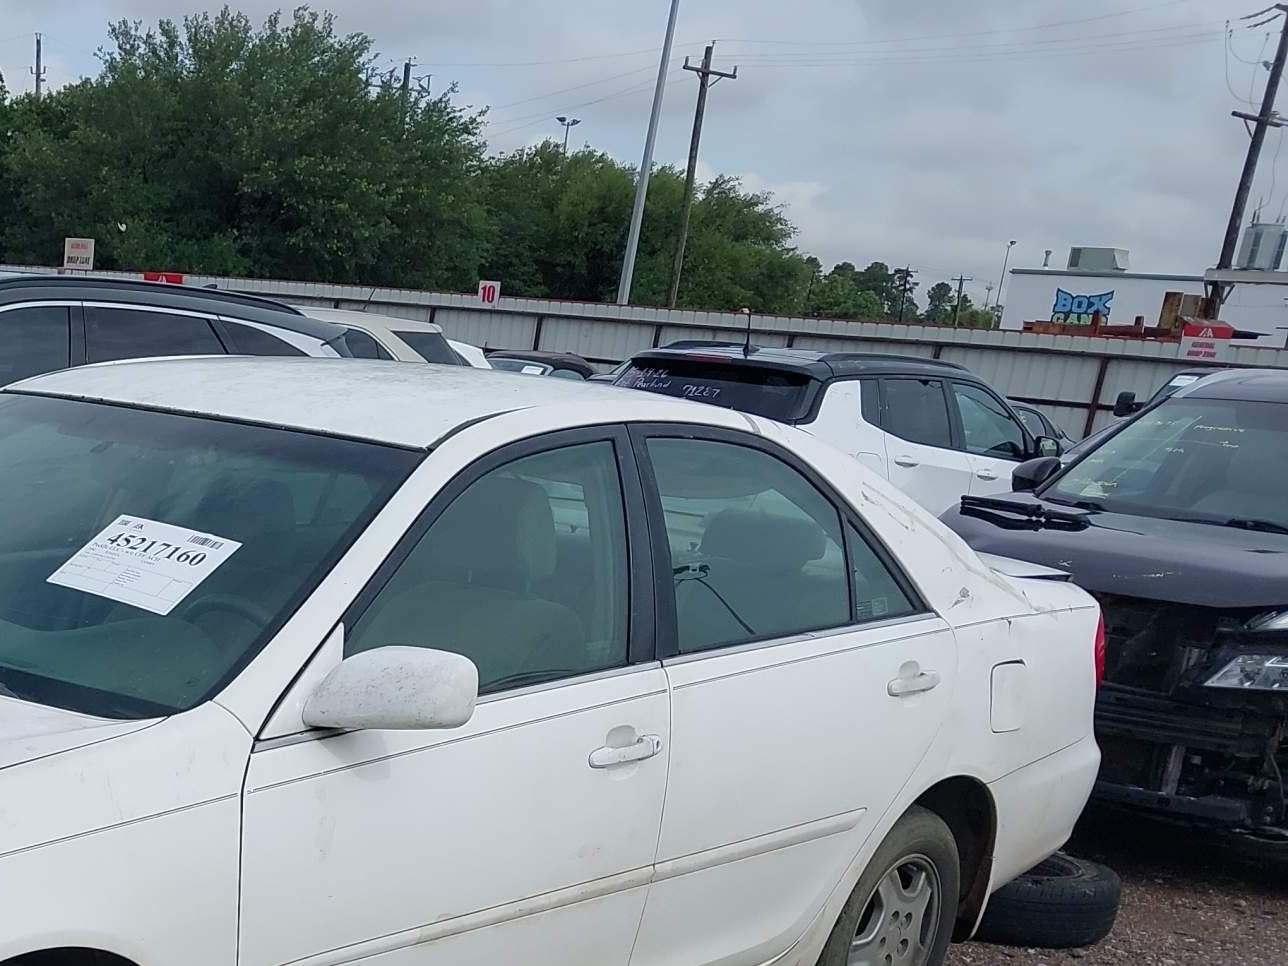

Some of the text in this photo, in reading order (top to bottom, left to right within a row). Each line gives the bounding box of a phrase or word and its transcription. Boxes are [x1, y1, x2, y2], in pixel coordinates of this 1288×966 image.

[481, 285, 496, 303] 10
[1053, 288, 1114, 315] BOX
[107, 533, 207, 566] 45217160
